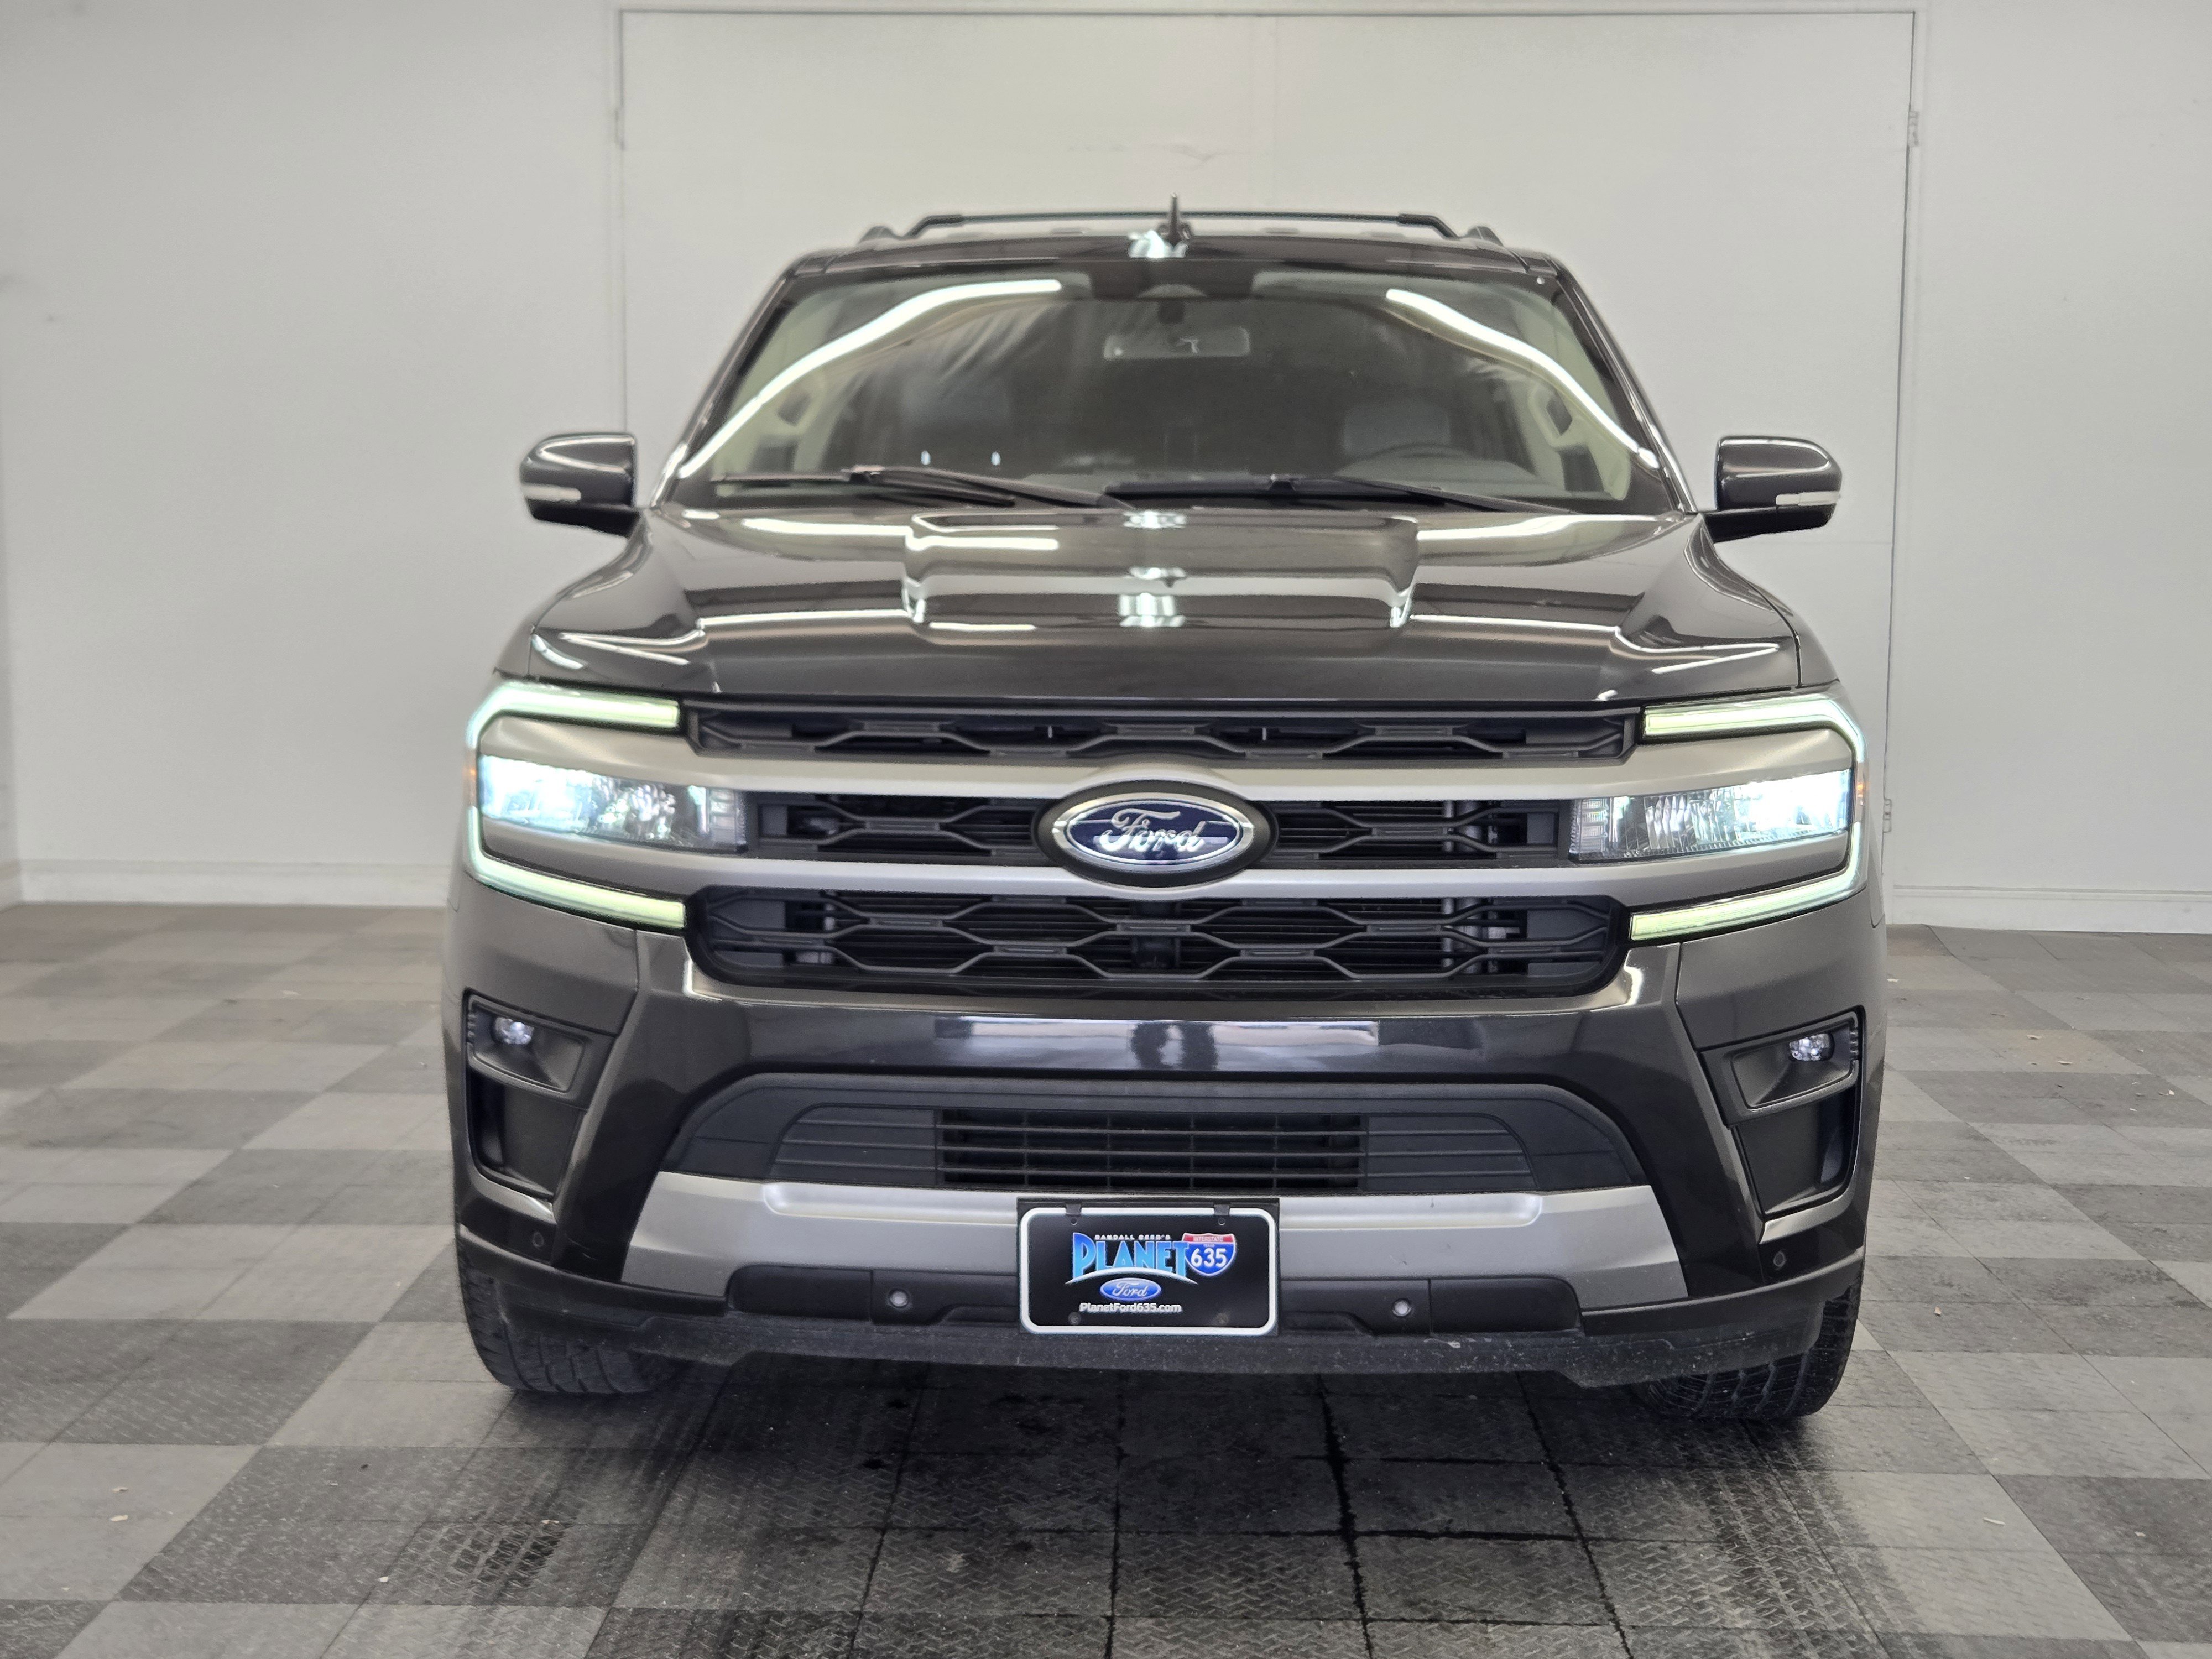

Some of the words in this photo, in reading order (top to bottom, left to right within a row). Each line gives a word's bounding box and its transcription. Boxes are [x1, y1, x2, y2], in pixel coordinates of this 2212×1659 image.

[1099, 808, 1205, 852] Ford
[1073, 1232, 1189, 1279] PLANET
[1191, 1248, 1227, 1267] 635
[1112, 1282, 1149, 1297] Ford
[1079, 1302, 1182, 1313] PlanetFord635.com
